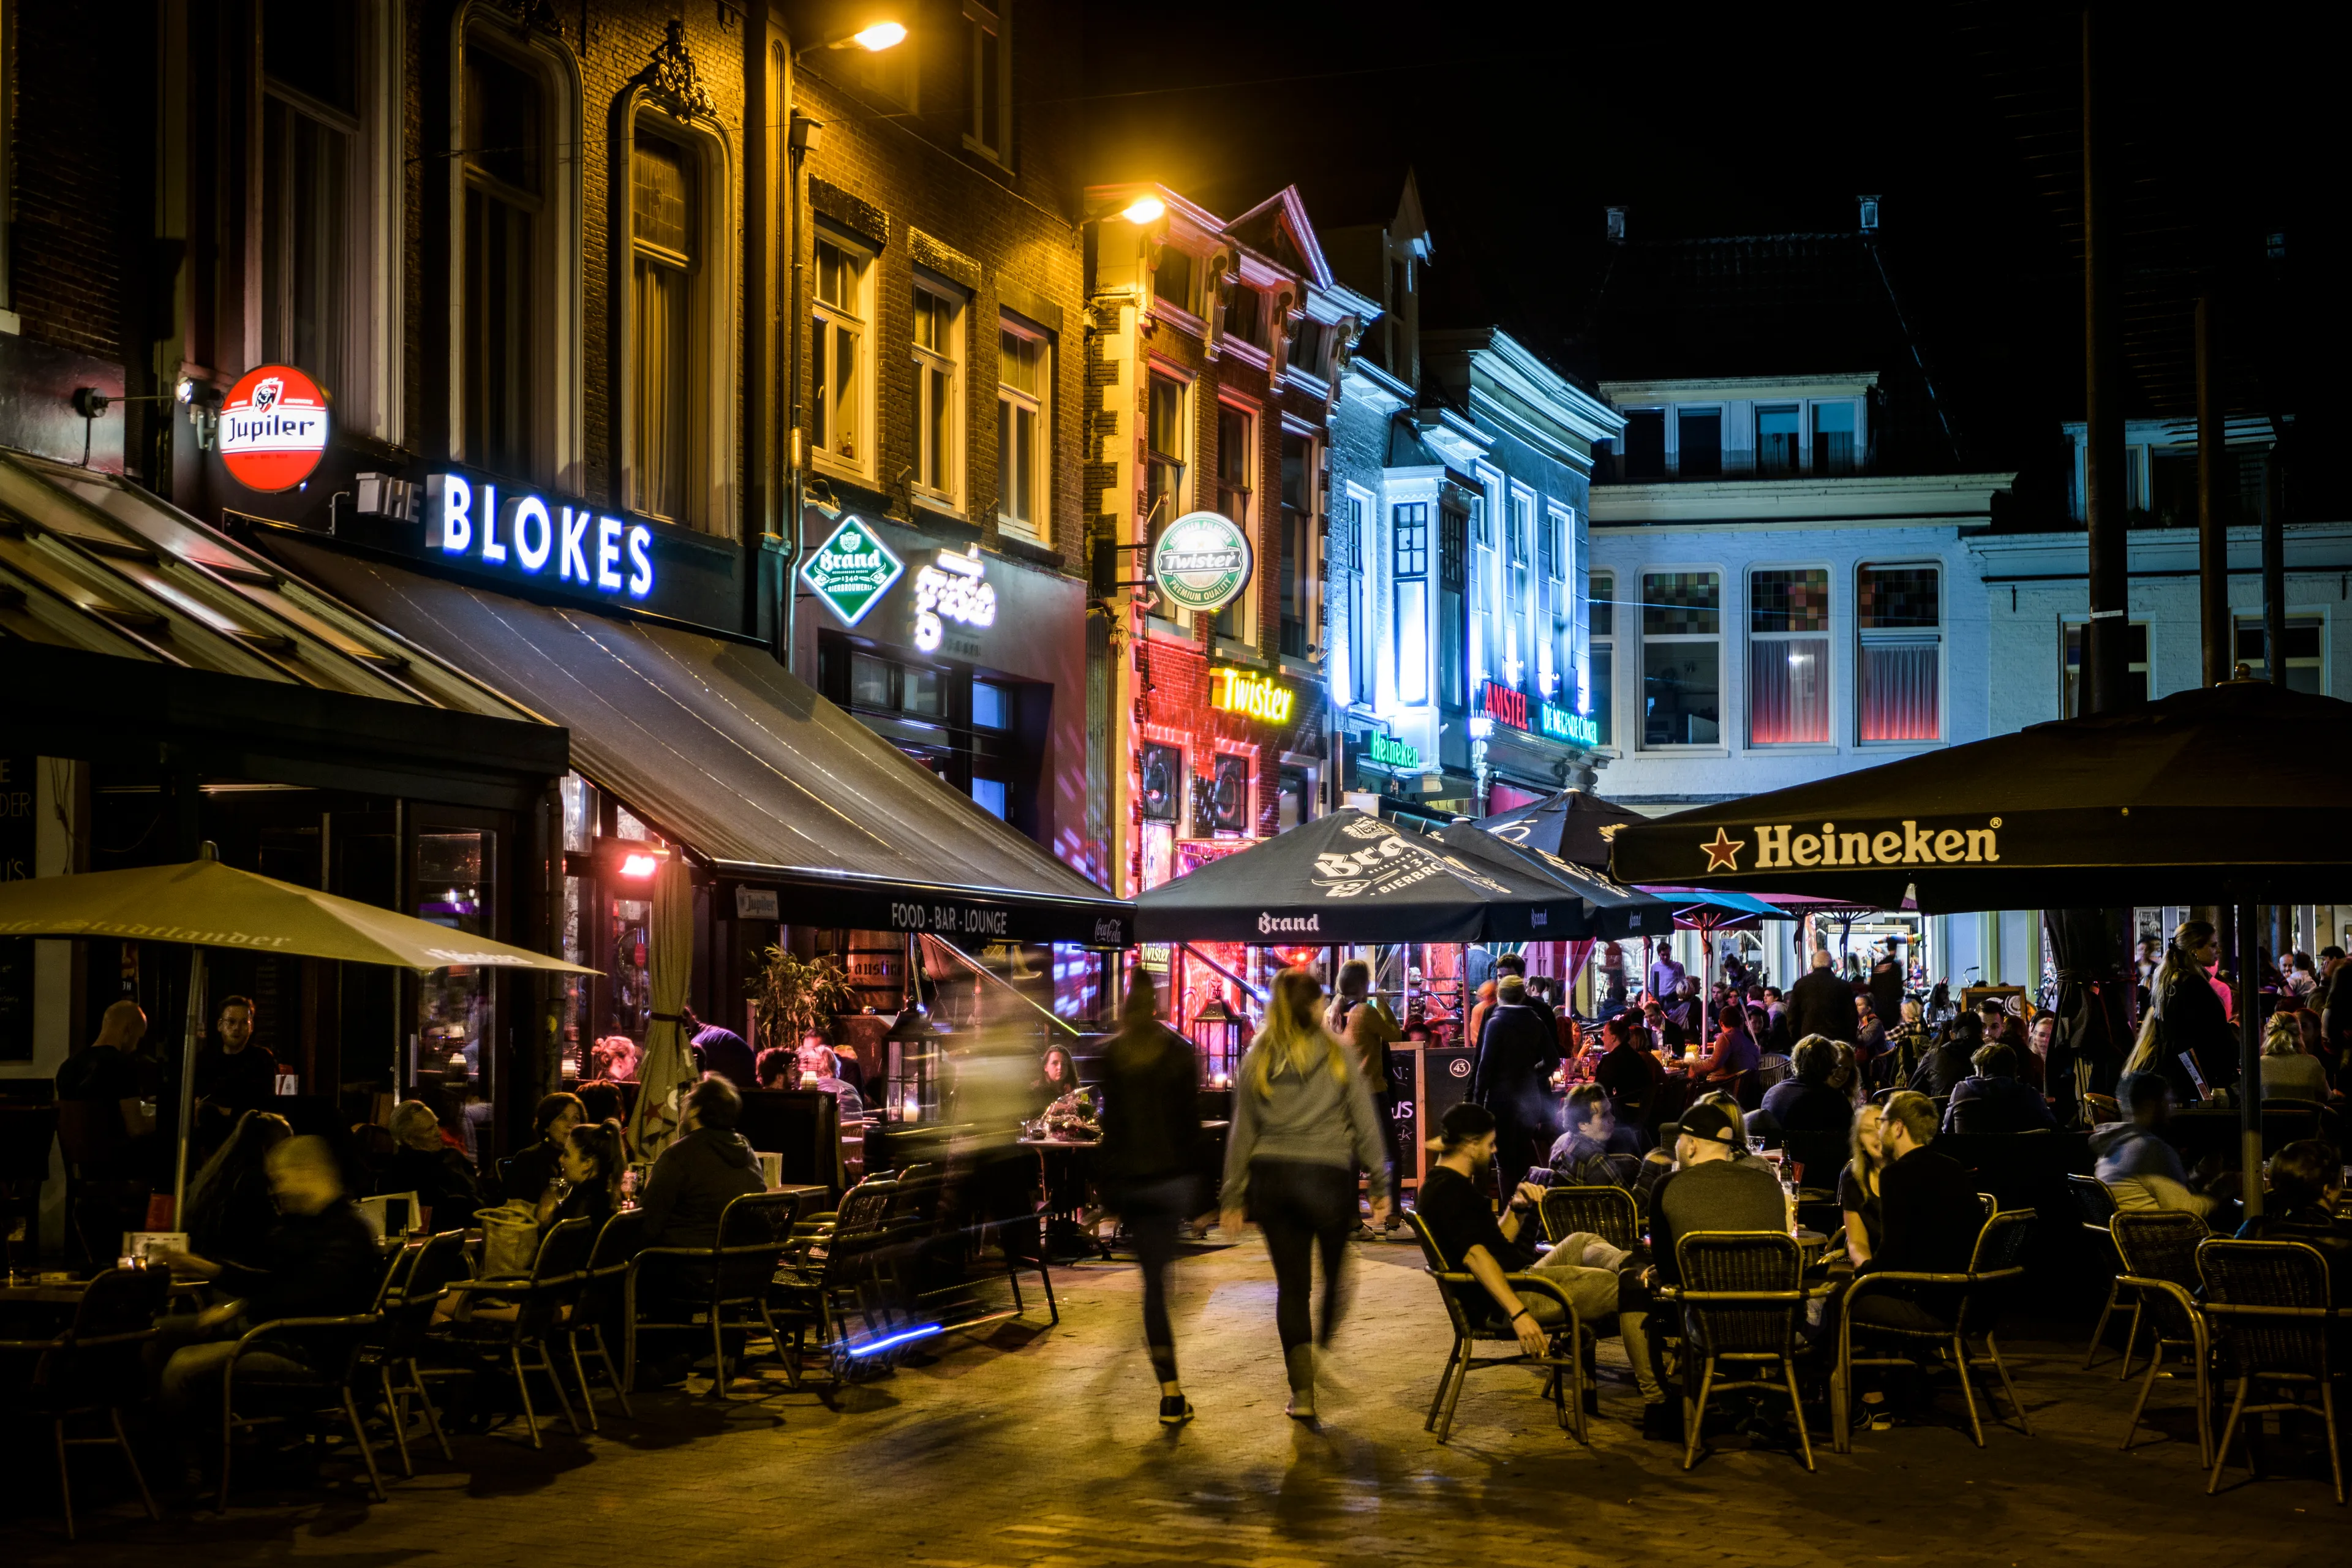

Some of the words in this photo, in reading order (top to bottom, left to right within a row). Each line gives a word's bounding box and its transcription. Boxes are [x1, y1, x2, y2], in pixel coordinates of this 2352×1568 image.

[228, 415, 315, 442] Jupiler
[356, 472, 423, 524] THE
[435, 473, 653, 595] BLOKES
[820, 548, 881, 573] Brand
[827, 583, 872, 592] BIERBROUWERIJ
[1169, 579, 1201, 601] PREMIUM
[1204, 578, 1232, 600] QUALITY
[1224, 668, 1292, 720] Twister
[1485, 682, 1528, 731] AMSTEL
[1542, 703, 1553, 731] DE
[1372, 729, 1419, 769] Heineken
[746, 895, 776, 913] Jupiler
[892, 903, 925, 929] FOOD
[935, 906, 956, 931] BAR
[965, 909, 1008, 935] LOUNGE
[1258, 911, 1320, 935] Brand
[1531, 908, 1548, 929] Brand
[1629, 911, 1642, 930] Brand
[1141, 943, 1170, 962] Twister
[847, 960, 903, 976] austino
[1453, 1063, 1466, 1072] 43
